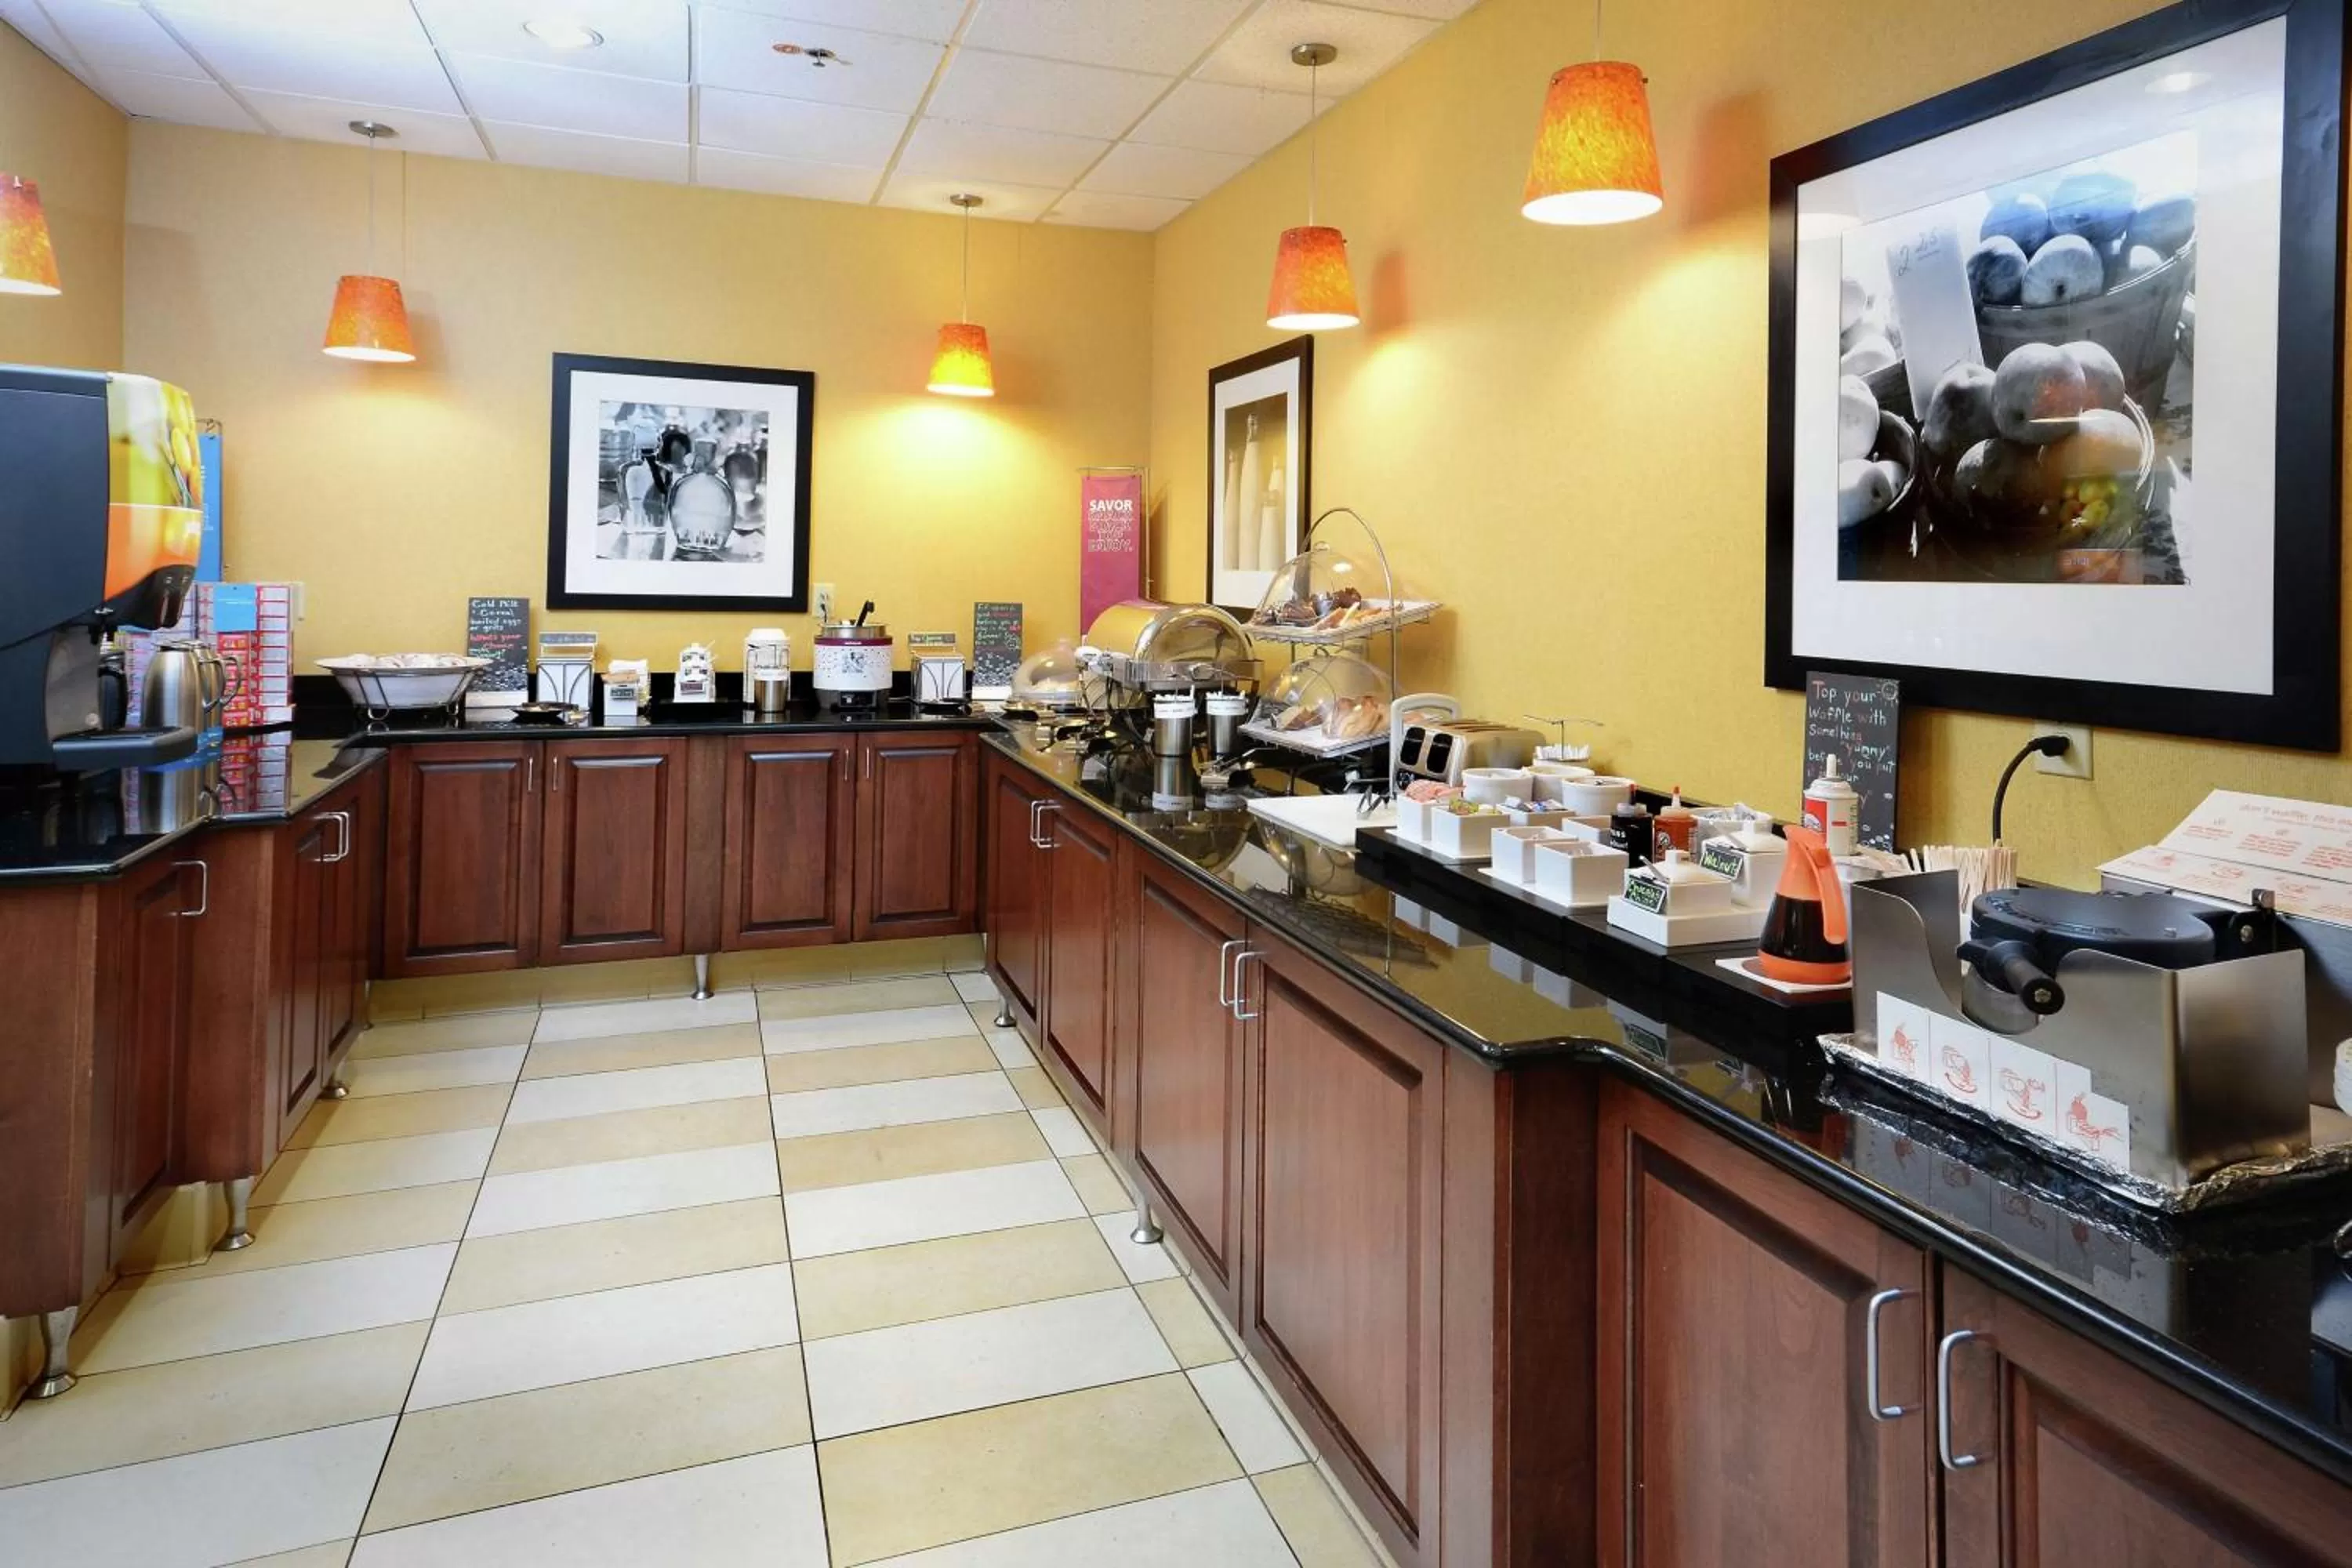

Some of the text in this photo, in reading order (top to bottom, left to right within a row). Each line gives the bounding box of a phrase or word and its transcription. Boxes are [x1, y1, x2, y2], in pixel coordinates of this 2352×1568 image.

[1089, 499, 1133, 512] SAVOR
[1812, 680, 1877, 708] Top your
[1809, 706, 1887, 726] Waffle with
[1809, 746, 1843, 766] befe
[1850, 758, 1872, 774] you
